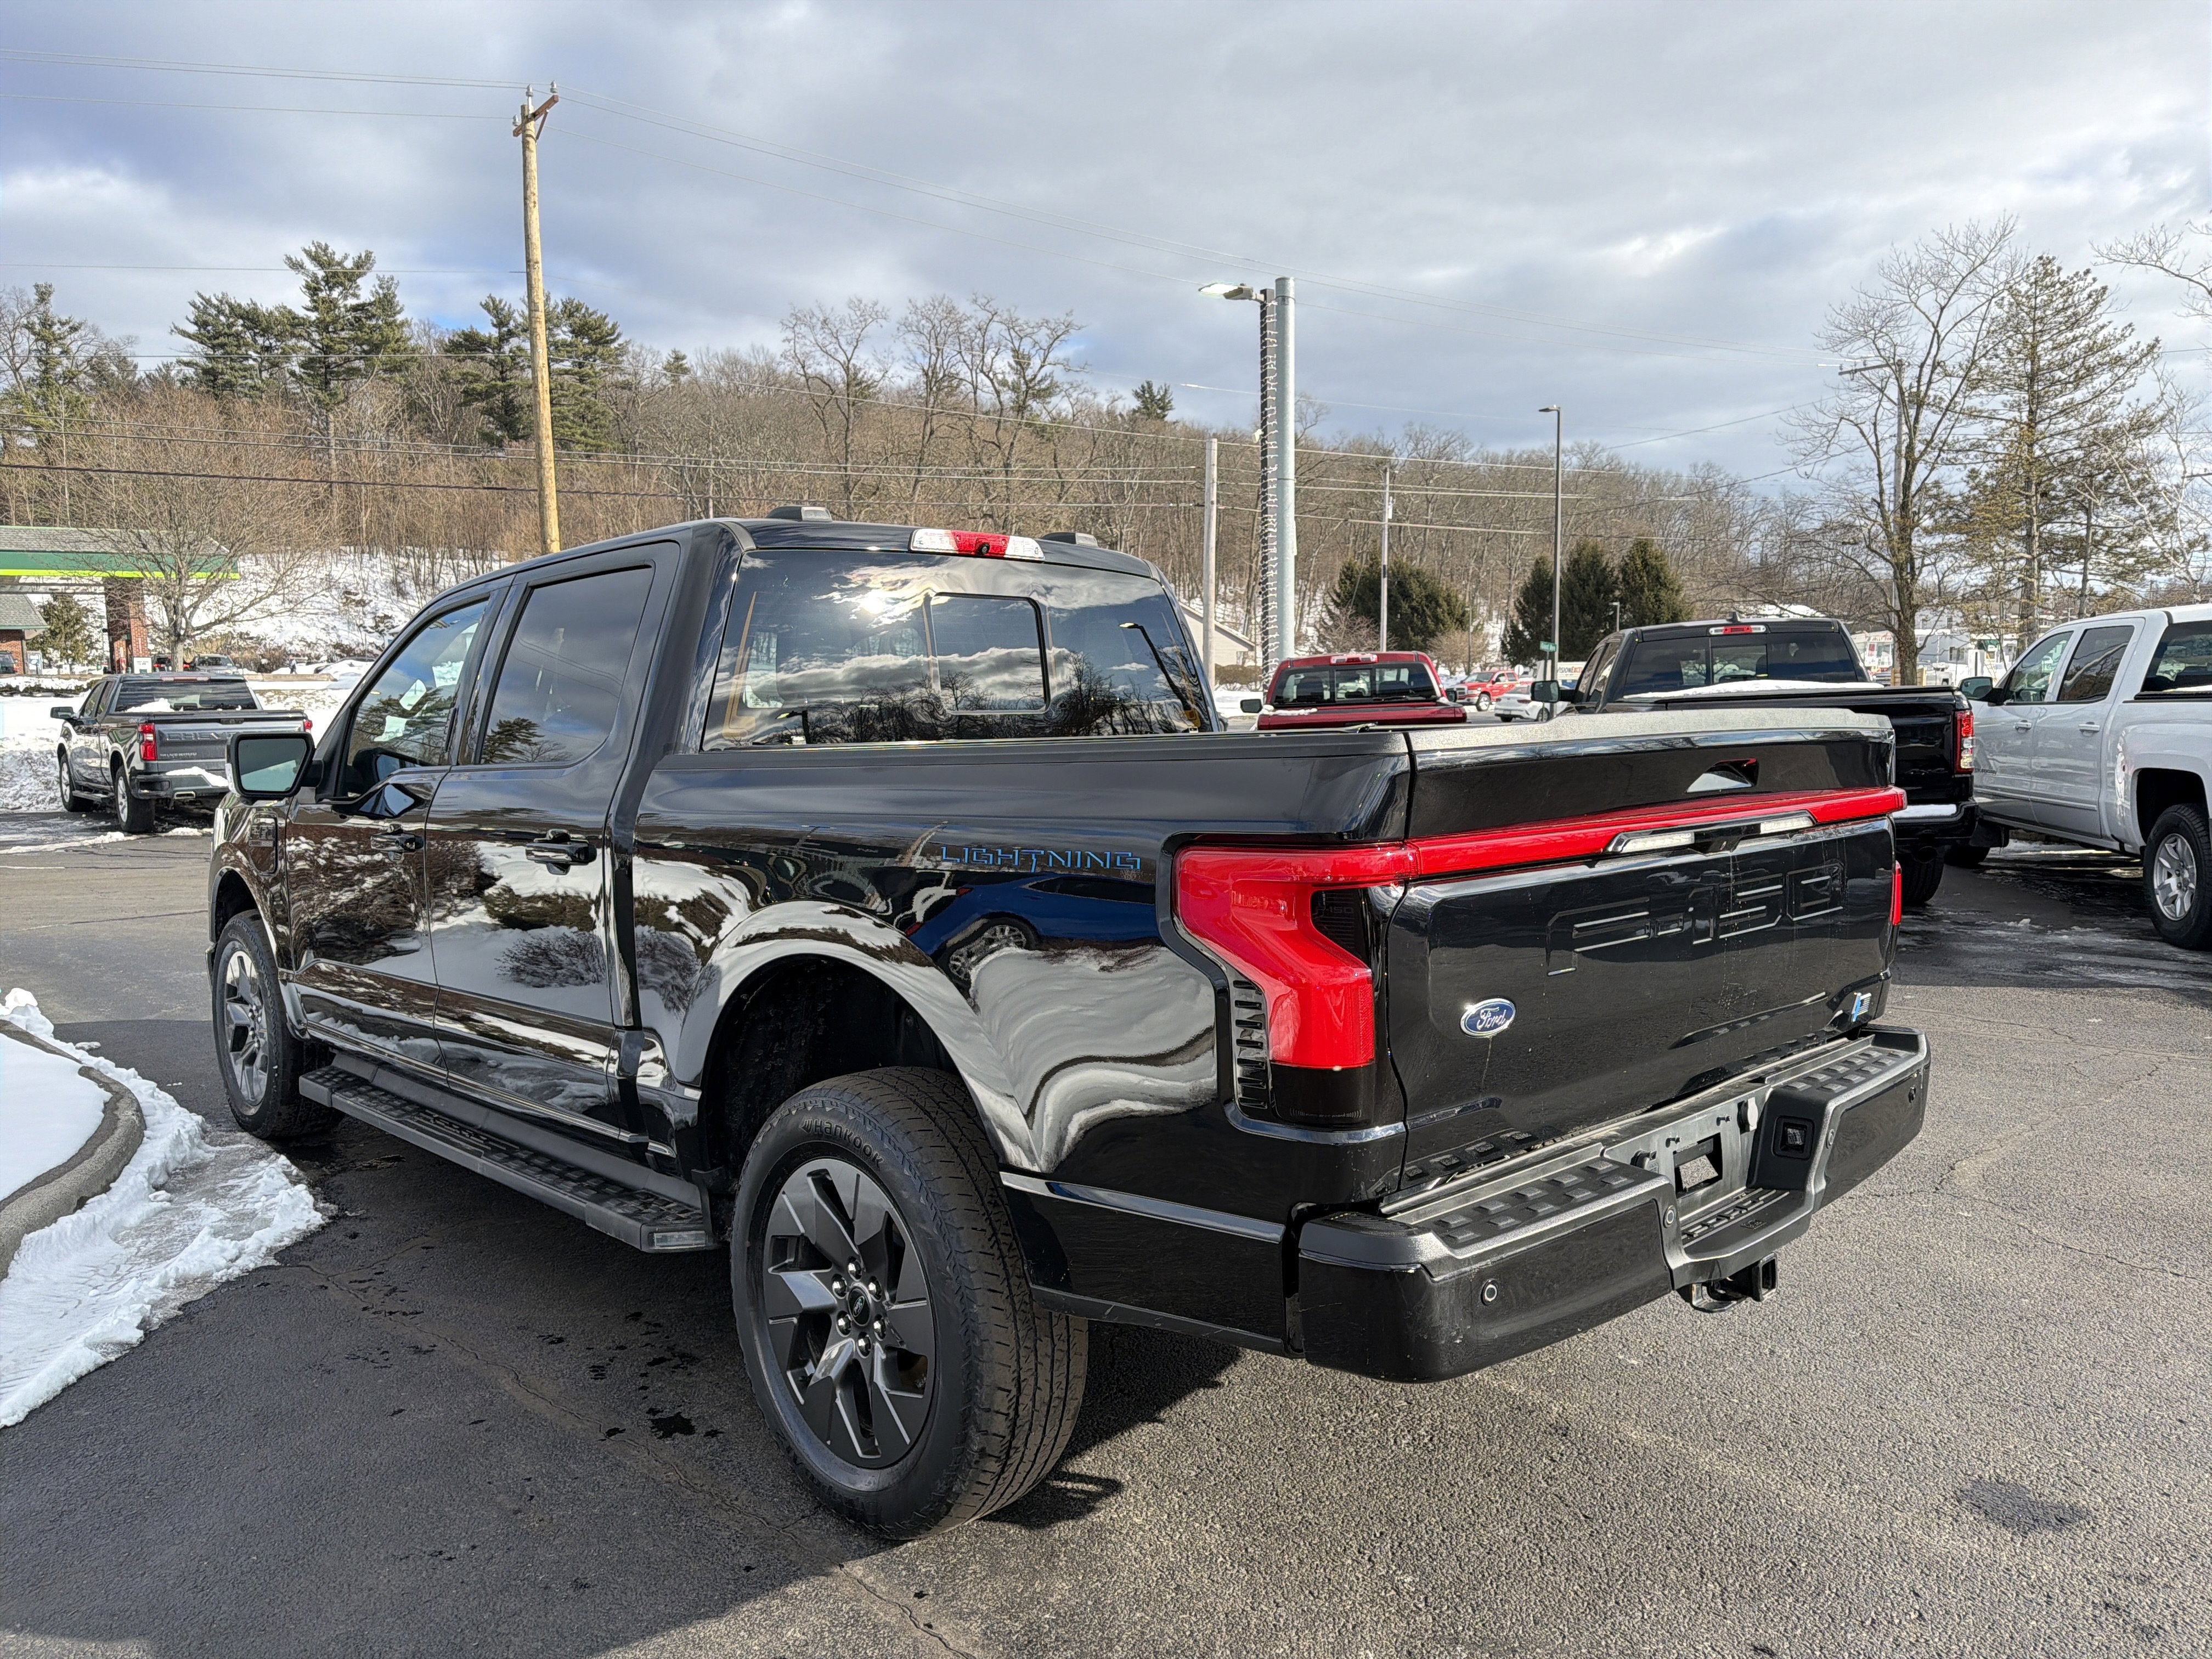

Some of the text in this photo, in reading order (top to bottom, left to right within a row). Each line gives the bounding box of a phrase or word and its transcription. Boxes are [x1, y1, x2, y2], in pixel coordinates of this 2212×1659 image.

[941, 846, 1142, 873] LIGHTNING
[1546, 860, 1844, 977] F-150
[1476, 1006, 1506, 1030] Ford
